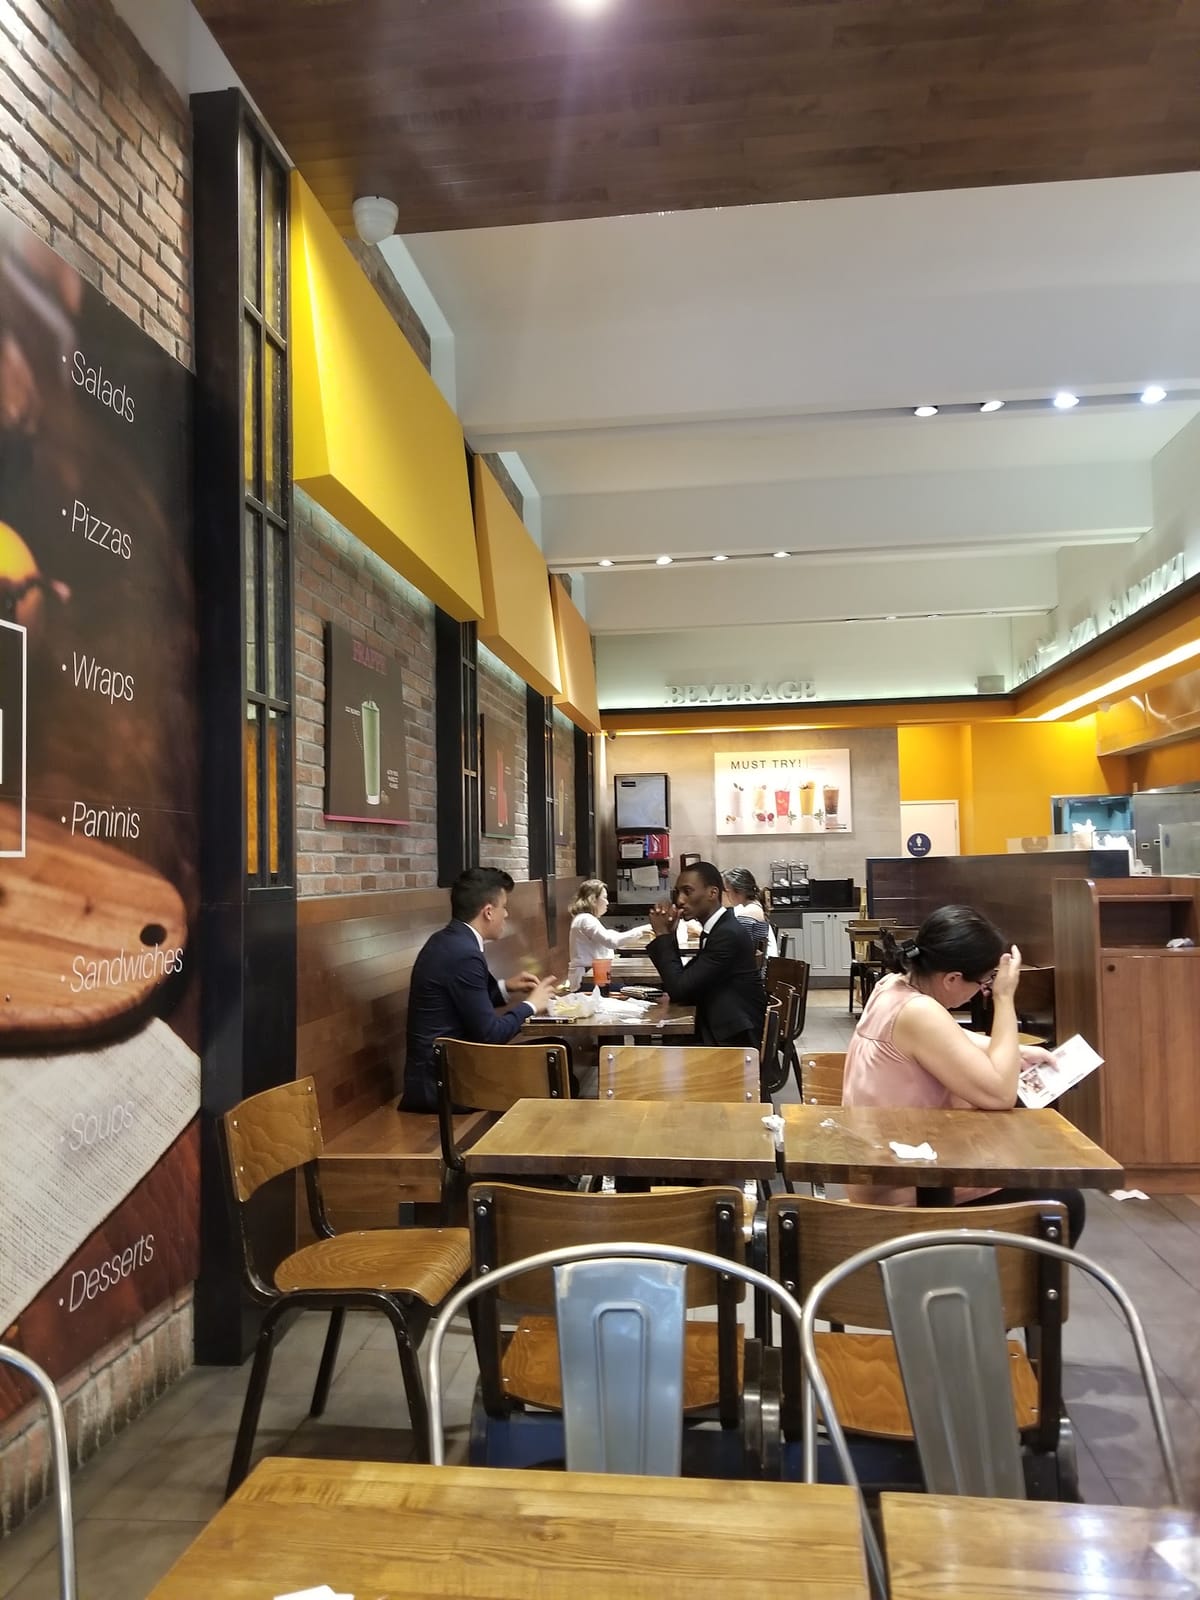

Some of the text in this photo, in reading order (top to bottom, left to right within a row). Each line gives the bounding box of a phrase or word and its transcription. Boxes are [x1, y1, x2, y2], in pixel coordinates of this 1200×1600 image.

[71, 350, 135, 423] Salads
[71, 499, 132, 560] Pizzas
[73, 651, 134, 705] Wraps
[664, 680, 817, 705] BEVERAGE
[730, 760, 767, 770] MUST
[772, 759, 801, 769] TRY!
[71, 801, 141, 839] Paninis
[70, 943, 184, 993] Sandwiches
[69, 1100, 135, 1152] Soups
[69, 1233, 155, 1313] Desserts
